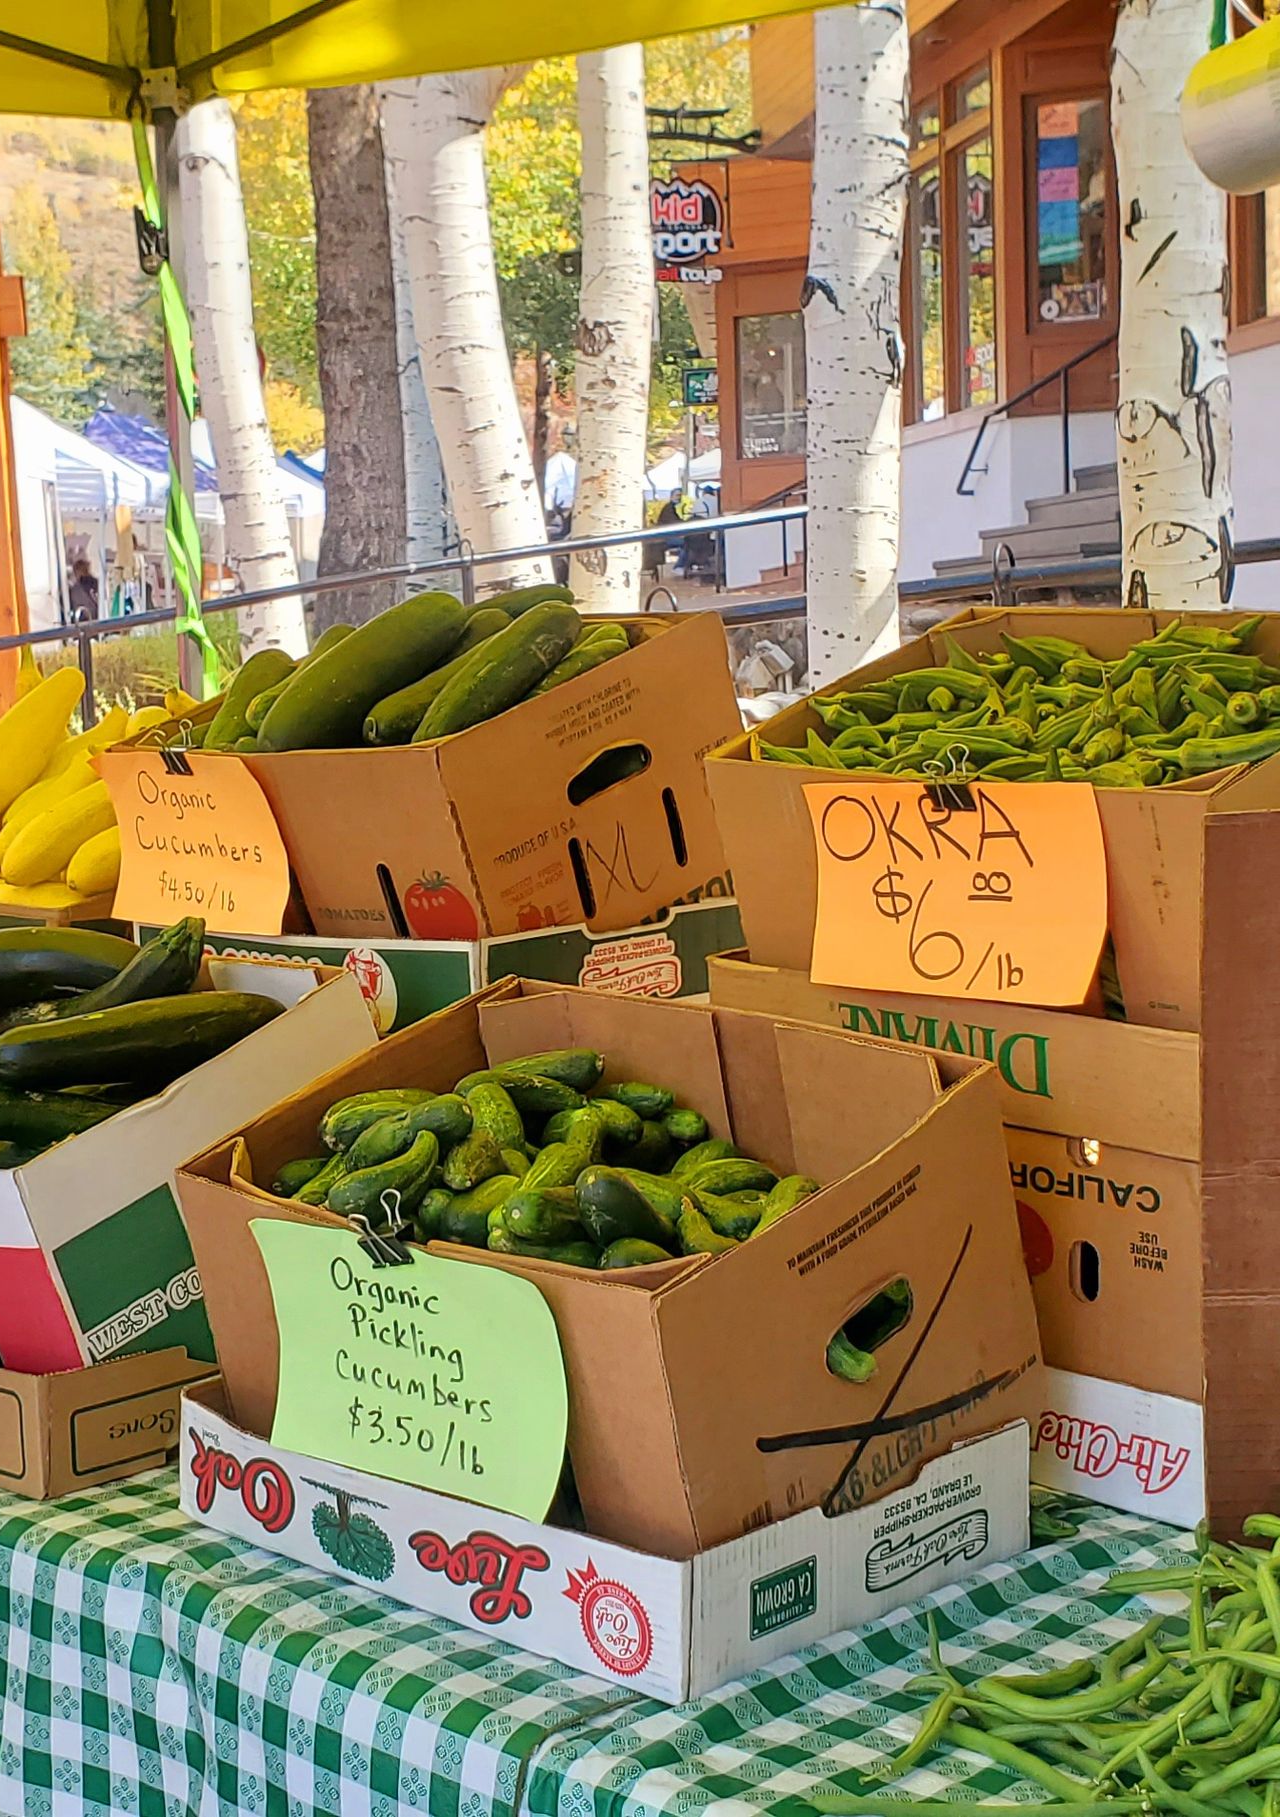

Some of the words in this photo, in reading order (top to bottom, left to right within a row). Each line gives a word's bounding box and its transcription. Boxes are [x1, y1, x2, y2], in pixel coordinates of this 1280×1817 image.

[651, 192, 703, 224] kid
[680, 267, 723, 285] toys
[137, 771, 216, 819] Organic
[136, 815, 262, 863] Cucumbers
[493, 838, 537, 866] PRODUCE
[538, 830, 550, 847] OF
[822, 788, 1034, 868] OKRA
[159, 870, 236, 913] $4.50/lb
[787, 1257, 796, 1271] TO
[796, 1236, 826, 1263] MAINTAIN
[826, 1213, 860, 1245] FRESHNESS
[798, 1260, 815, 1277] WITH
[815, 1256, 822, 1266] A
[821, 1243, 839, 1263] FOOD
[838, 1231, 858, 1250] GRADE
[858, 1204, 889, 1237] PETROLEUM
[1129, 1242, 1168, 1260] BEFORE
[1138, 1231, 1159, 1246] USE
[331, 1257, 440, 1314] Organic
[1133, 1257, 1165, 1273] WASH
[87, 1292, 164, 1356] WEST
[348, 1303, 464, 1383] Pickling
[336, 1349, 492, 1423] Cucumbers
[108, 1408, 176, 1439] Sons
[349, 1396, 484, 1475] $3.50/lb
[188, 1426, 297, 1534] Oak
[929, 1477, 961, 1498] GRAND,
[962, 1473, 973, 1487] LE
[873, 1485, 982, 1540] GROWER-PACKER-SHIPPER
[407, 1529, 550, 1625] Live
[756, 1579, 796, 1617] GROWN
[797, 1571, 811, 1595] CA
[594, 1606, 630, 1633] Oak
